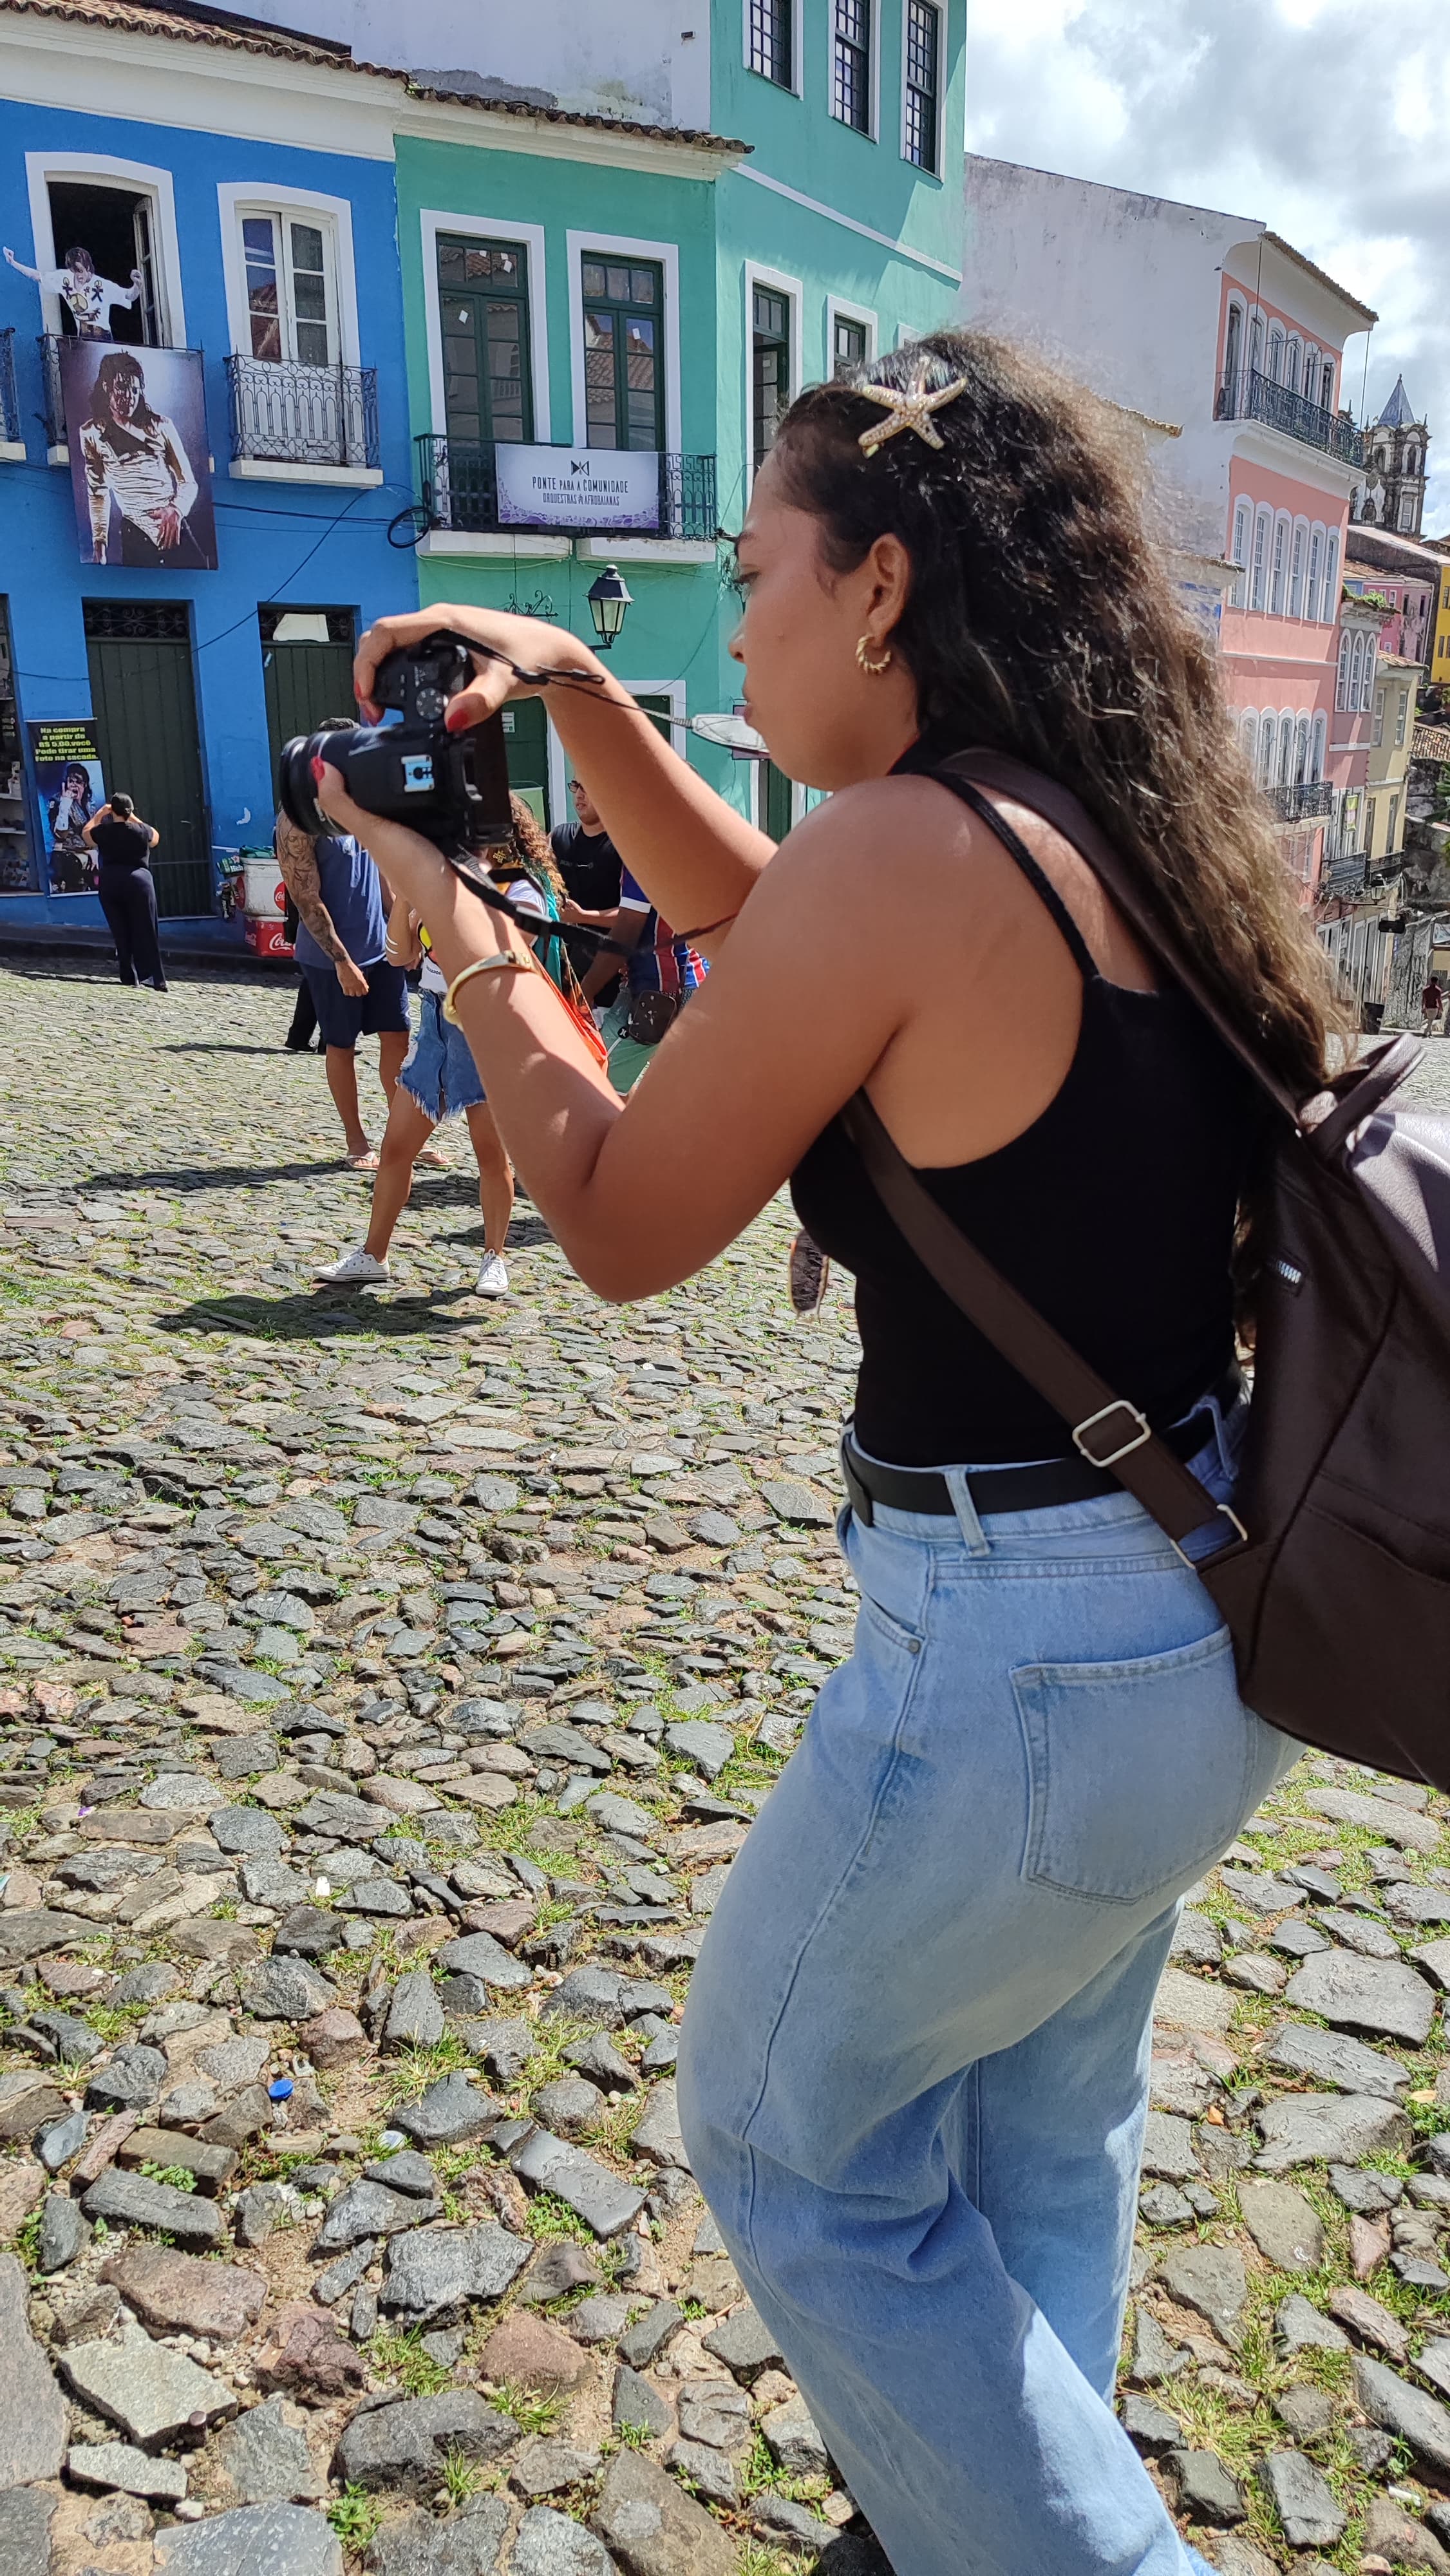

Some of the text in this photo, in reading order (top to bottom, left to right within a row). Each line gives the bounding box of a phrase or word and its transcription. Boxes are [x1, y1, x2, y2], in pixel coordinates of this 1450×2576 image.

[532, 476, 628, 493] PONTE PARA A COMUNIDADE
[543, 492, 619, 506] ORQUESTRAS AFROBAIANAS
